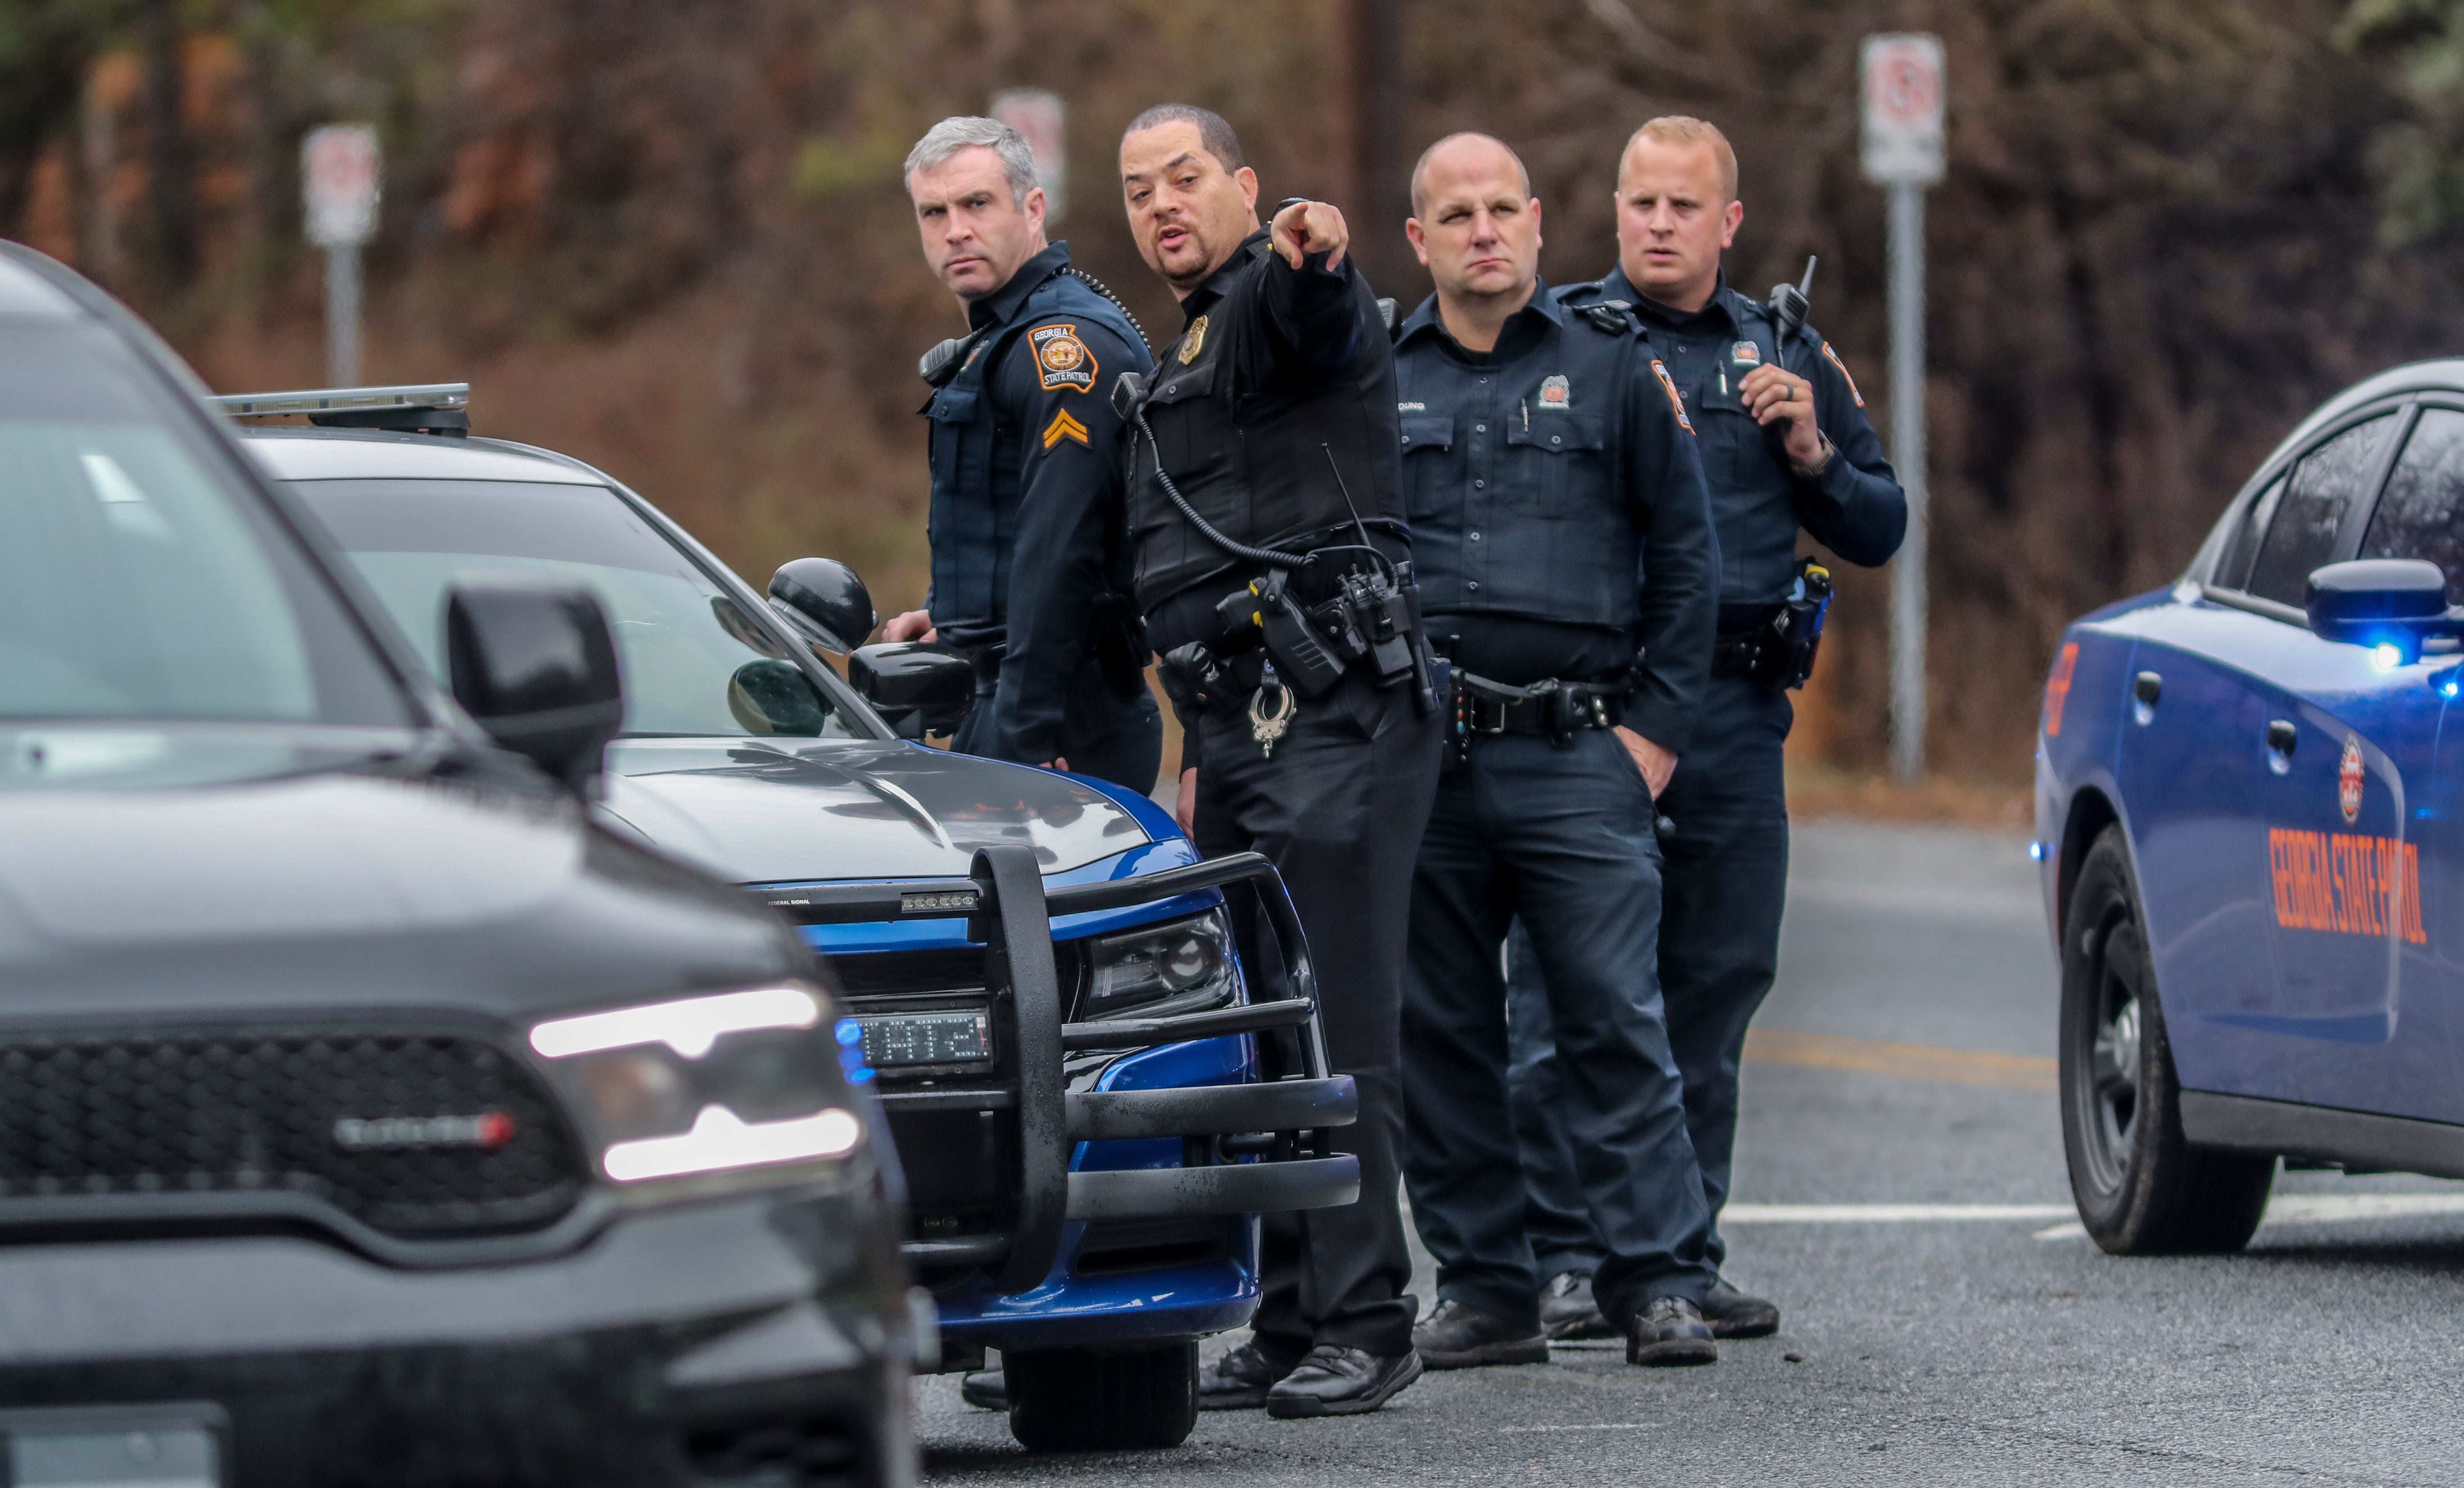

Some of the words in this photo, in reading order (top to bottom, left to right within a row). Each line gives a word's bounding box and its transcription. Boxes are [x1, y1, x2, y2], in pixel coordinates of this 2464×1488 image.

[1035, 328, 1068, 340] GEORGIA
[1045, 372, 1066, 384] STATE
[1066, 371, 1092, 382] PATROL
[2269, 828, 2338, 932] GEORGIA
[2332, 833, 2381, 936] STATE
